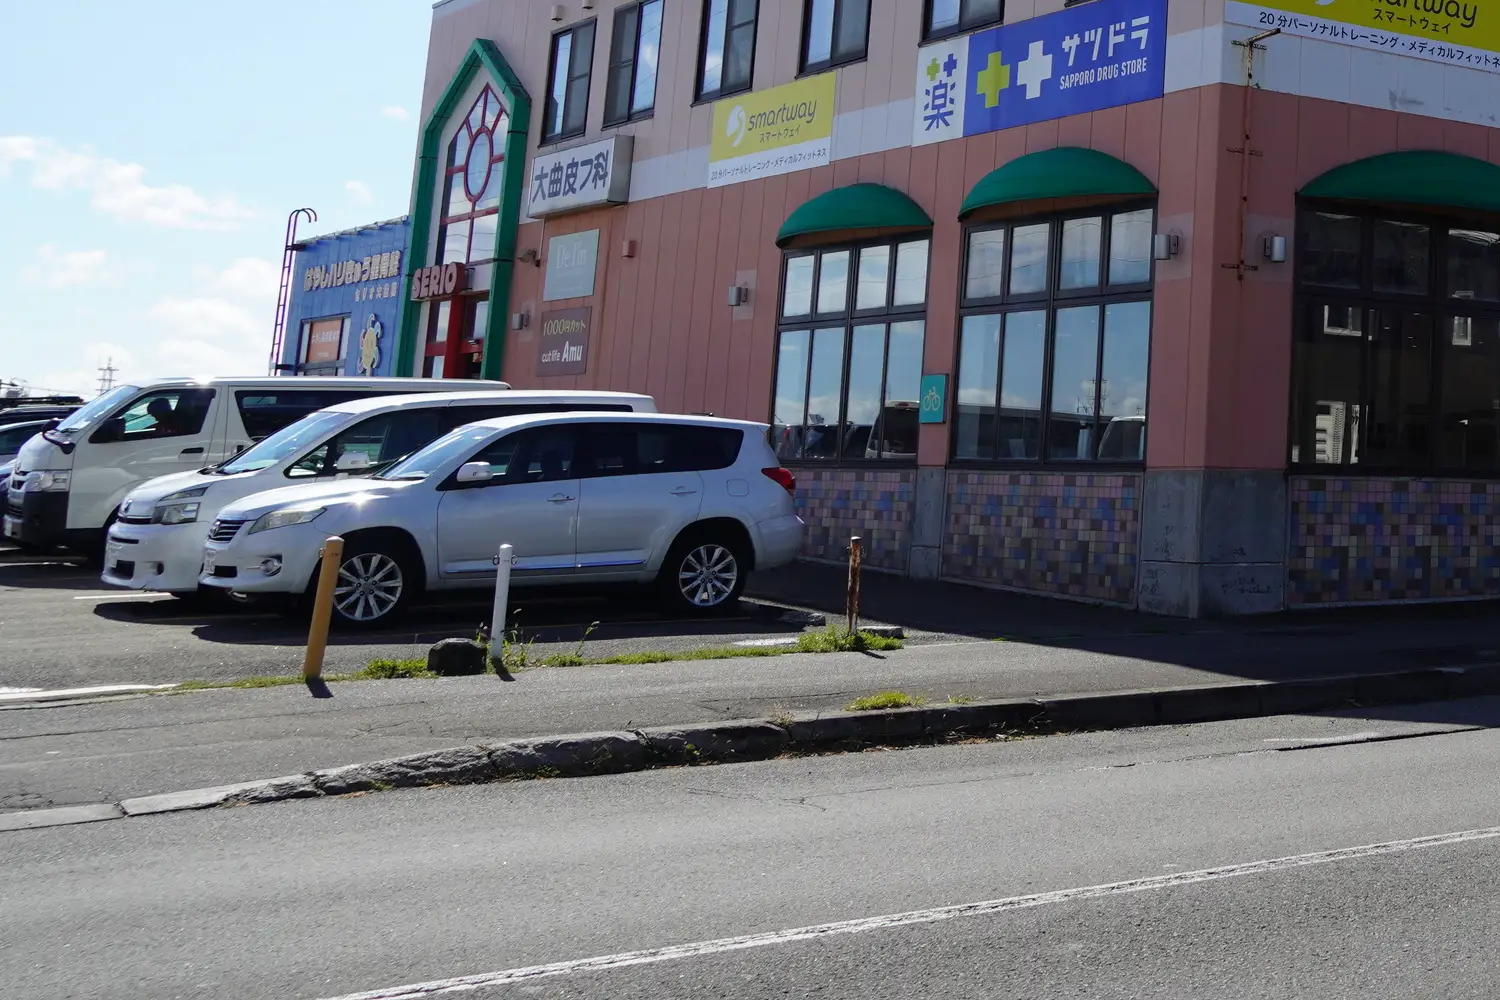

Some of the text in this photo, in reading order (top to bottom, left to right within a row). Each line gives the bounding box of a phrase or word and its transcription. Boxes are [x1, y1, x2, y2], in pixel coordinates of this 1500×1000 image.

[1373, 8, 1452, 35] スマートウェイ
[1062, 16, 1150, 67] サツドラ
[1060, 57, 1148, 90] SAPPORO DRUG STORE
[748, 100, 817, 131] smartway
[923, 80, 957, 132] 楽
[760, 124, 801, 143] スマートウェイ
[534, 151, 610, 203] 大曲皮フ科
[412, 262, 458, 299] SERIO
[561, 340, 583, 362] Amu
